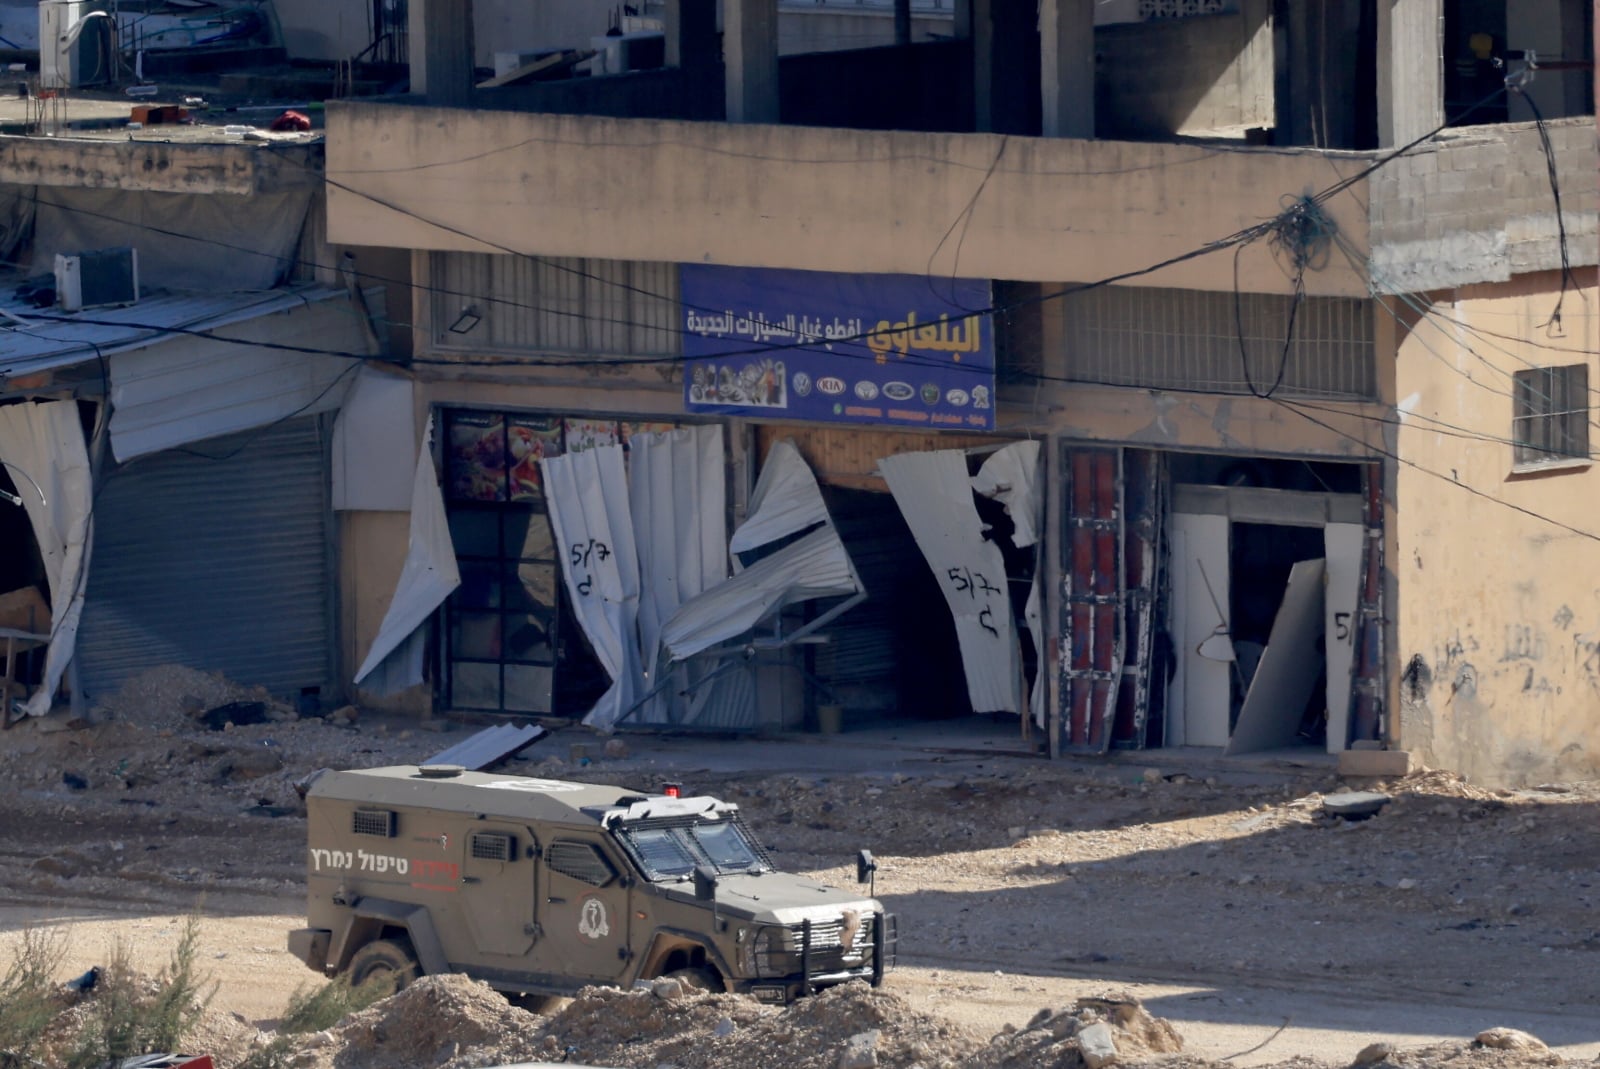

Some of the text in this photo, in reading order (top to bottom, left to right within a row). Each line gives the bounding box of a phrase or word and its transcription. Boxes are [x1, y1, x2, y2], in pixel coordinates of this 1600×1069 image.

[687, 309, 733, 339] الجديدة
[310, 848, 353, 871] נמרץ
[357, 848, 408, 875] טיפול
